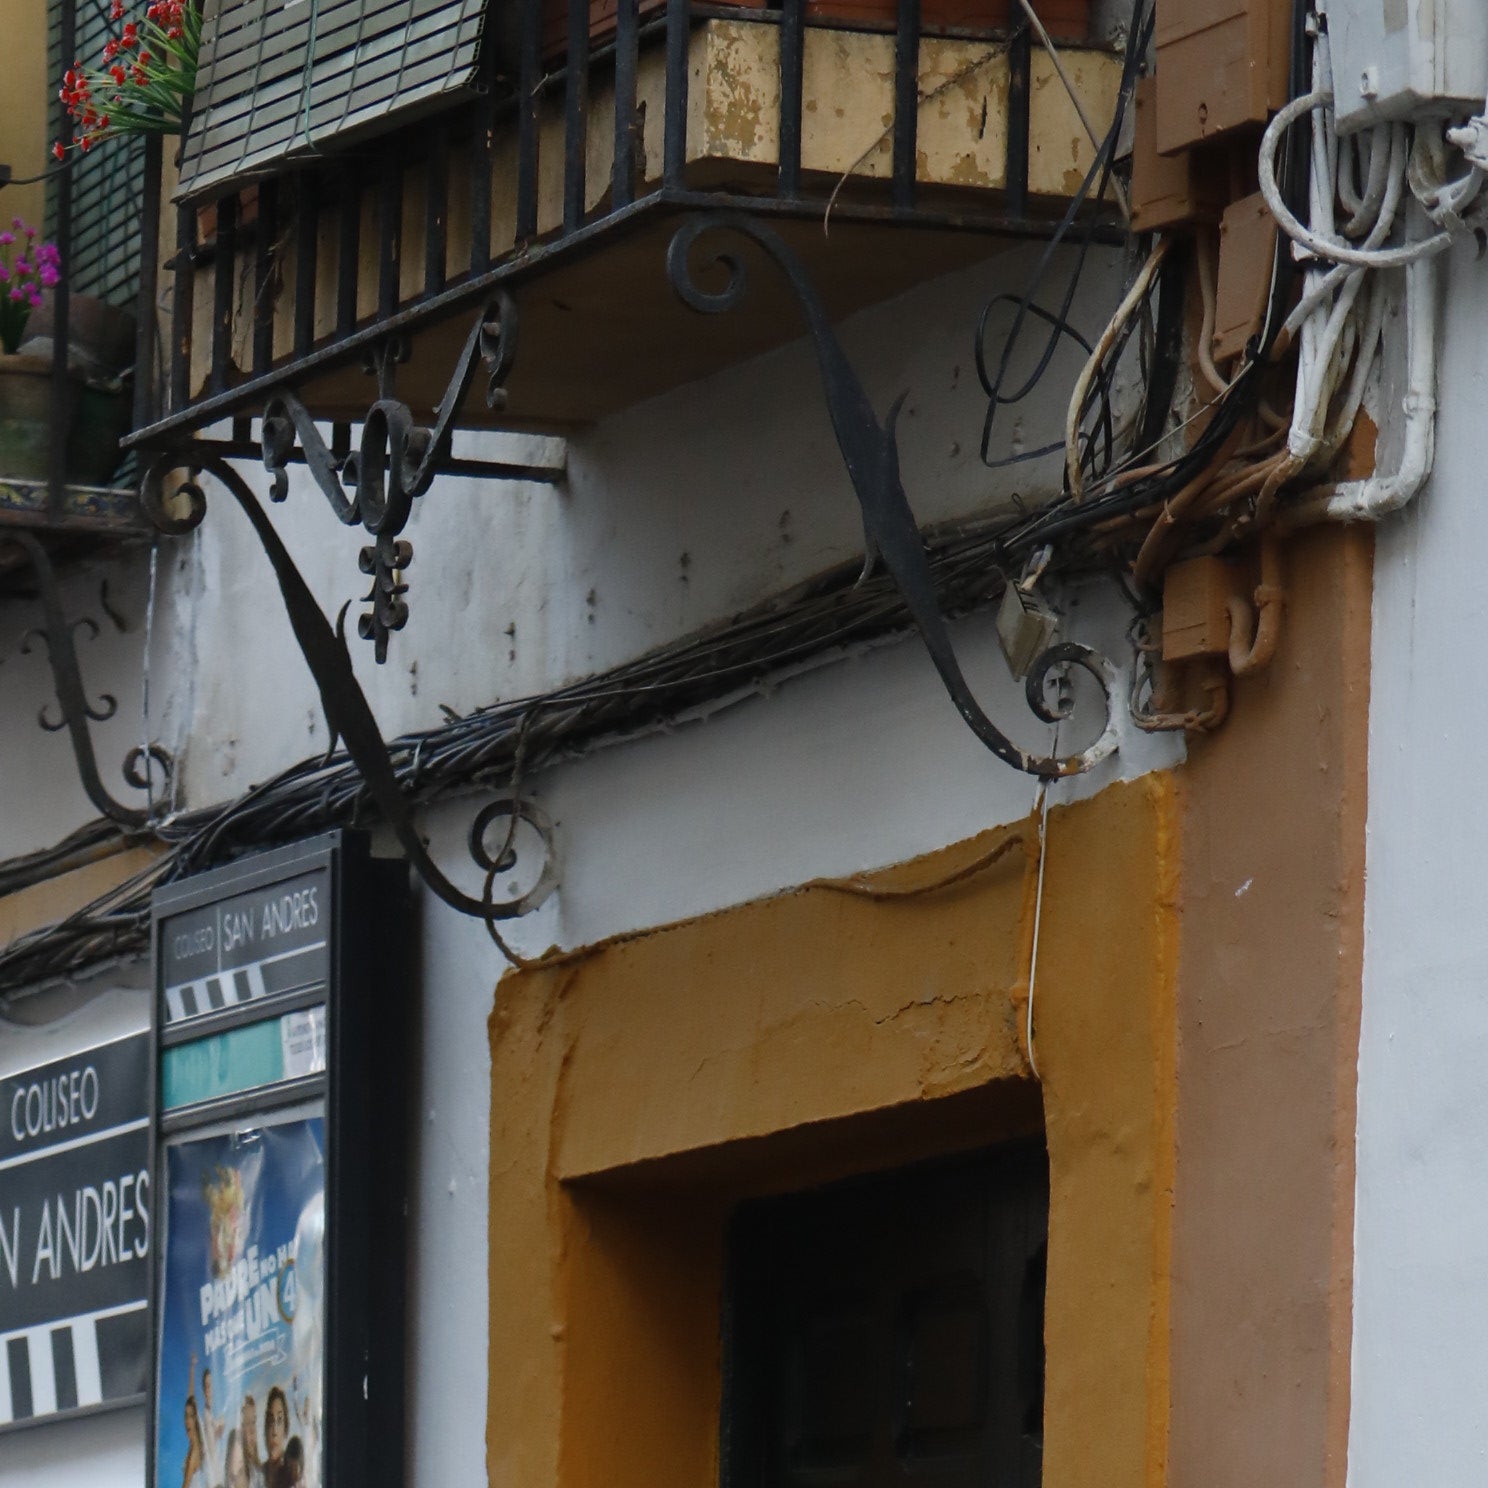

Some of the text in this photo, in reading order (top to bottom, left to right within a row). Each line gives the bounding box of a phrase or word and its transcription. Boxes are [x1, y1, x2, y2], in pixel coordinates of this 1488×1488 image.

[224, 906, 256, 951] SAN
[262, 887, 319, 937] ANDRES
[11, 1066, 99, 1141] COLISEO
[33, 1168, 150, 1284] ANDRES
